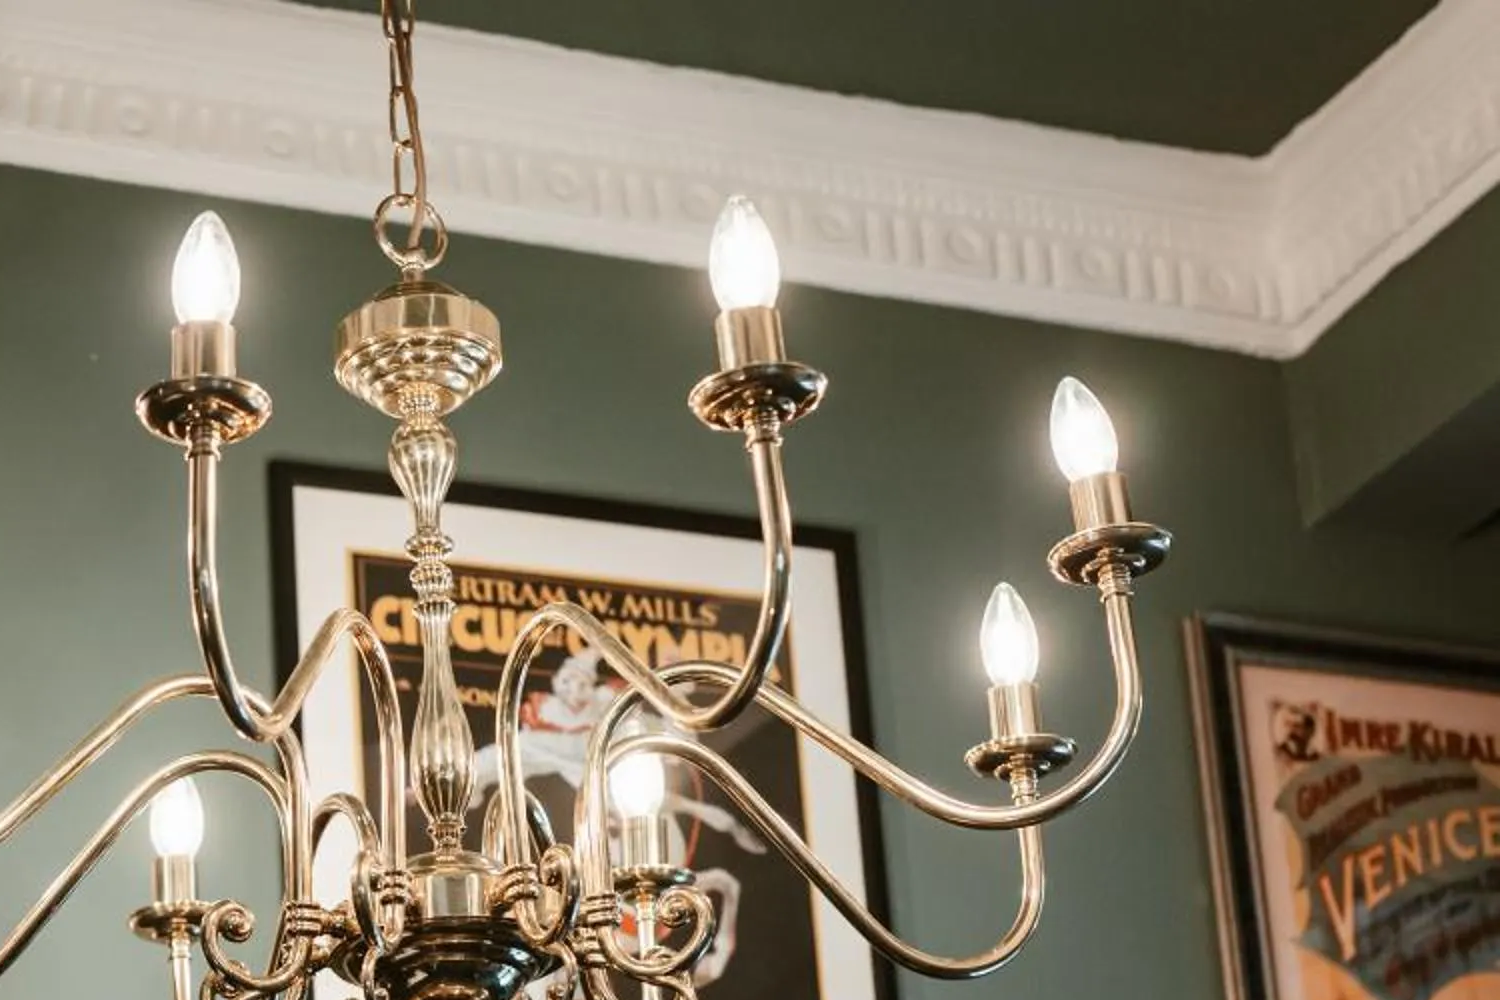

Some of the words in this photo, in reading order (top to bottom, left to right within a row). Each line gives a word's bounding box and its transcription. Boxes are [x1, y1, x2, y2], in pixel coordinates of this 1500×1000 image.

[455, 576, 568, 607] RTRAM
[621, 593, 720, 627] MILLS
[1409, 721, 1500, 766] KIRAL
[1319, 806, 1500, 960] VENICE
